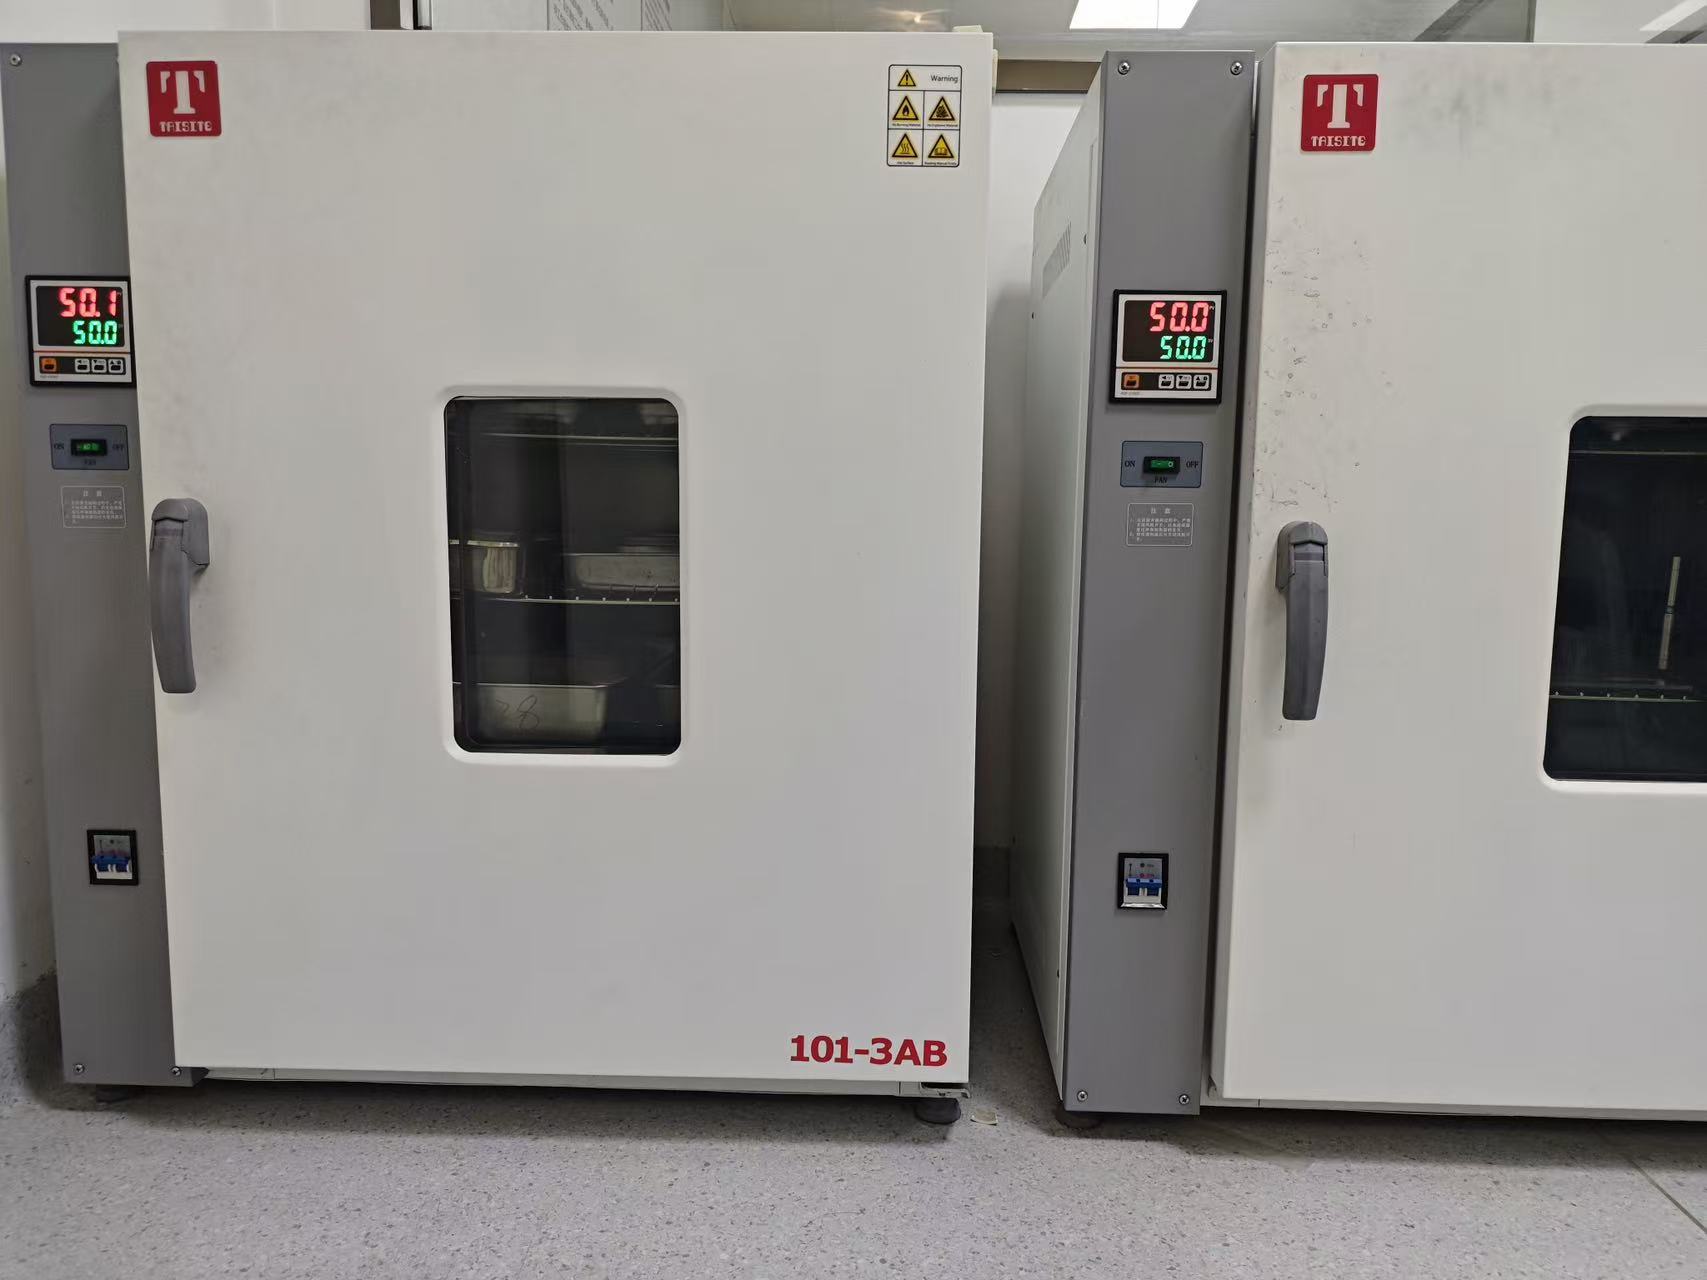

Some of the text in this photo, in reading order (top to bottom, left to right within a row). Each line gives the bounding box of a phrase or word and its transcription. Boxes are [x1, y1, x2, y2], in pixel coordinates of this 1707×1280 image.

[160, 70, 206, 114] T
[931, 75, 959, 84] Warning
[1316, 84, 1364, 129] T
[1310, 135, 1367, 147] TAISITE
[58, 287, 117, 317] 50.1
[1149, 302, 1209, 332] 50.0
[72, 320, 118, 345] 50.0
[1159, 335, 1207, 360] 50.0
[1124, 460, 1199, 469] ON OFF
[1154, 476, 1168, 484] FAN
[790, 1034, 948, 1067] 101-3AB
